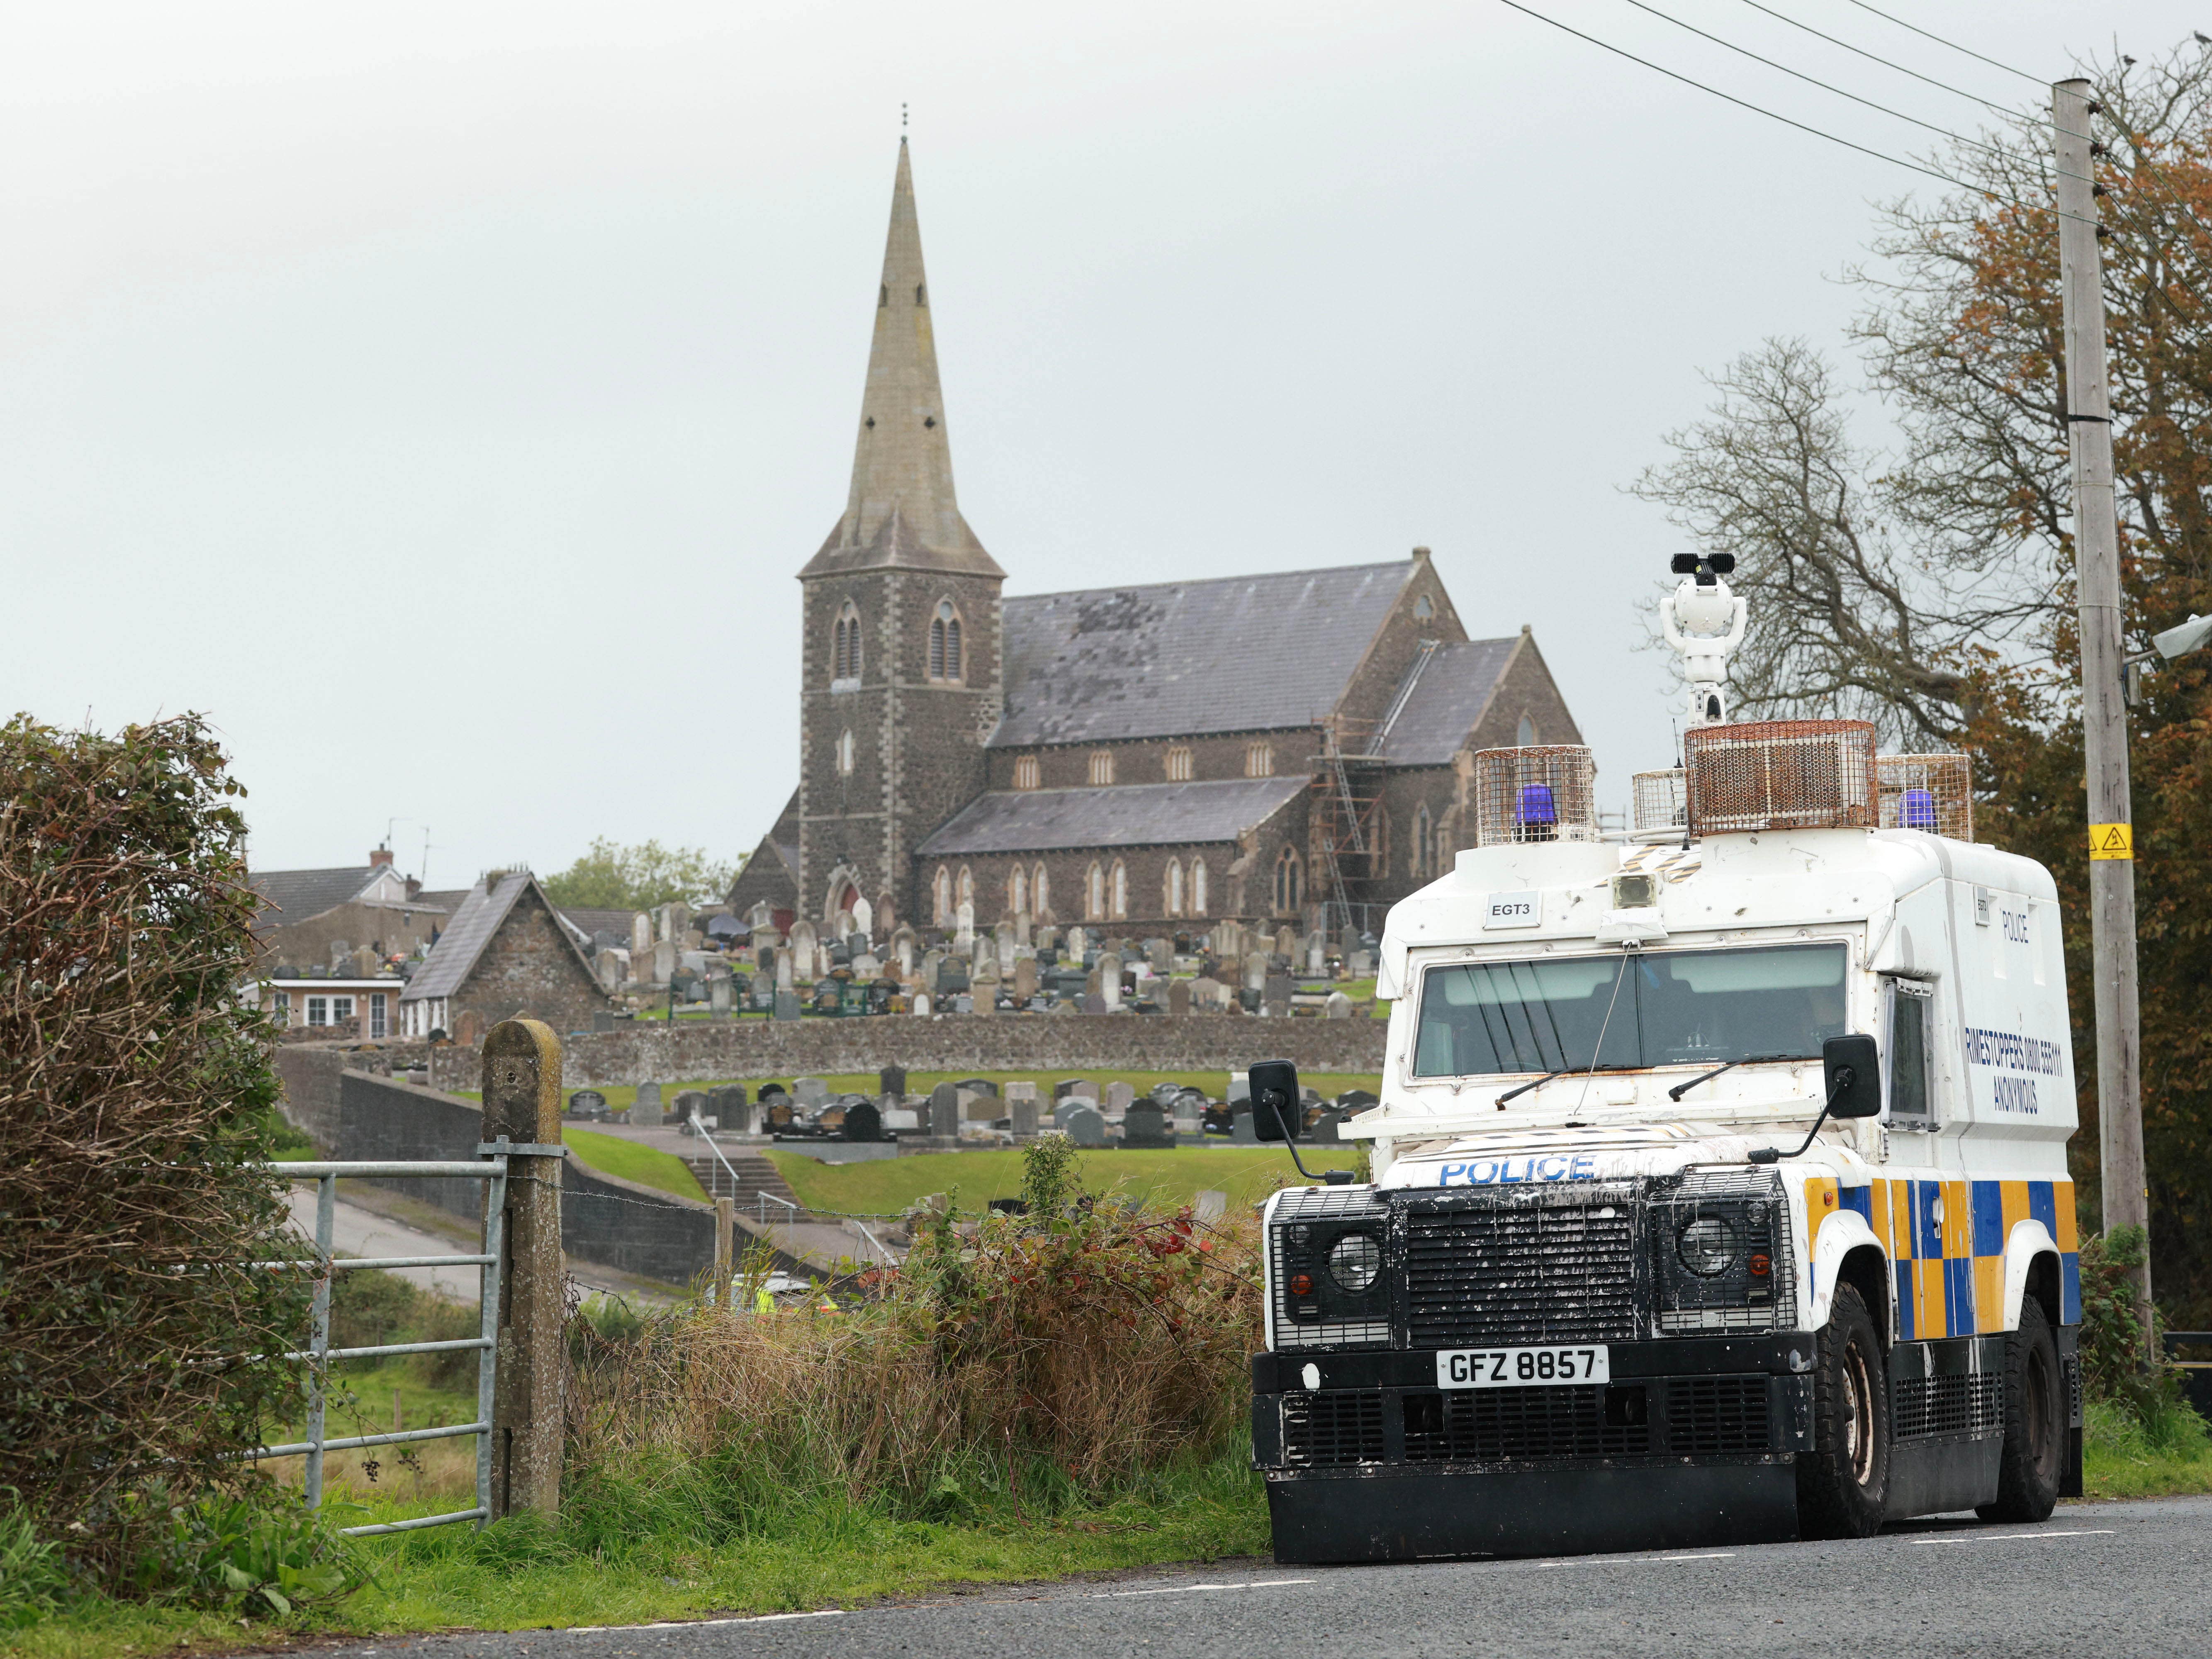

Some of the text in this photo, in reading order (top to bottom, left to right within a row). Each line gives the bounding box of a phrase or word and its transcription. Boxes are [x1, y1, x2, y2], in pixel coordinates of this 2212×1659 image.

[1492, 904, 1530, 915] EGT3
[1978, 899, 1987, 912] EGT3
[2003, 911, 2029, 944] POLICE
[1965, 1027, 2062, 1077] RIMESTOPPERS 0800 555111
[1994, 1075, 2037, 1114] ANONYMOUS
[1439, 1155, 1597, 1186] POLICE
[1450, 1350, 1595, 1382] GFZ 8857
